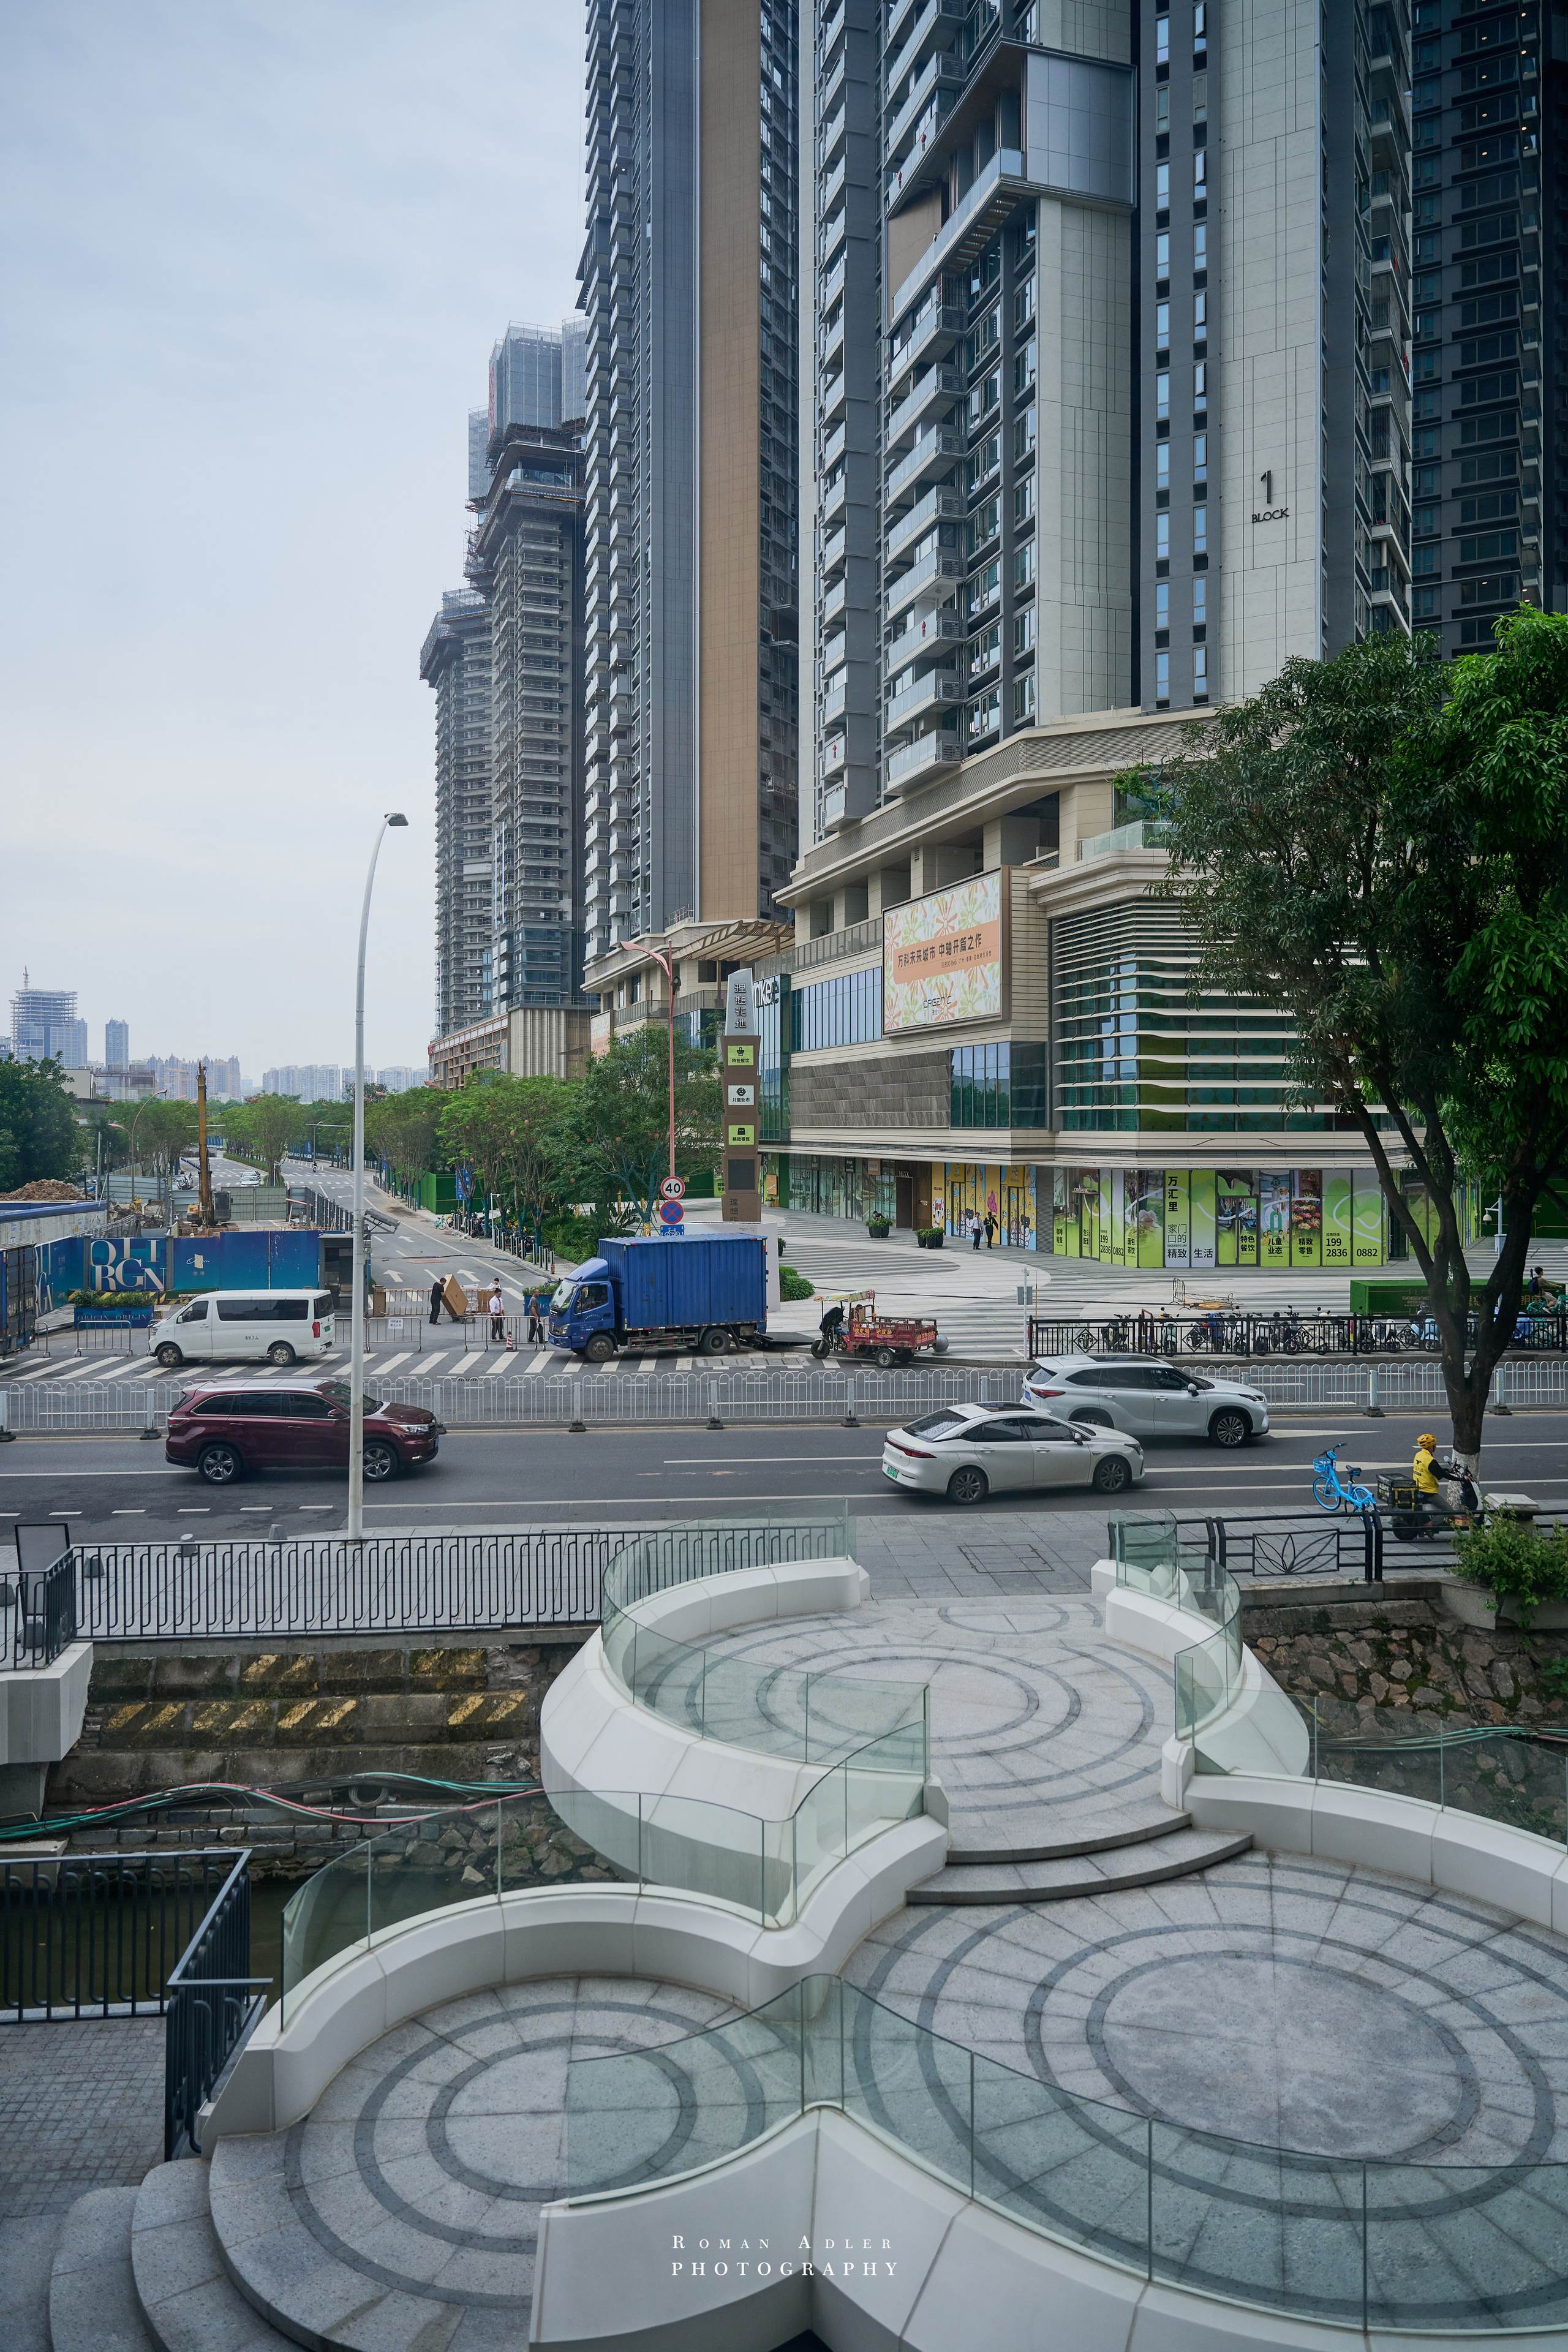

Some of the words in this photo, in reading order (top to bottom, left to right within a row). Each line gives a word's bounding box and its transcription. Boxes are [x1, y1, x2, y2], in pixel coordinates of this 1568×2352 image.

[1261, 470, 1271, 503] 1
[1251, 508, 1289, 523] BLOCK
[898, 946, 935, 968] 万科未来城市
[939, 933, 982, 957] 中轴开篇之作
[734, 983, 746, 1028] 理想花地
[665, 1183, 680, 1193] 40
[1167, 1176, 1178, 1212] 万汇里
[1168, 1224, 1187, 1234] 家门
[1127, 1237, 1135, 1246] 面包
[1168, 1234, 1186, 1243] 口的
[1326, 1238, 1341, 1246] 199
[1100, 1245, 1111, 1254] 2836
[1113, 1246, 1124, 1256] 0882
[1167, 1248, 1187, 1258] 精致
[1194, 1248, 1213, 1258] 生活
[1326, 1248, 1348, 1257] 2836
[1357, 1248, 1378, 1257] 0882
